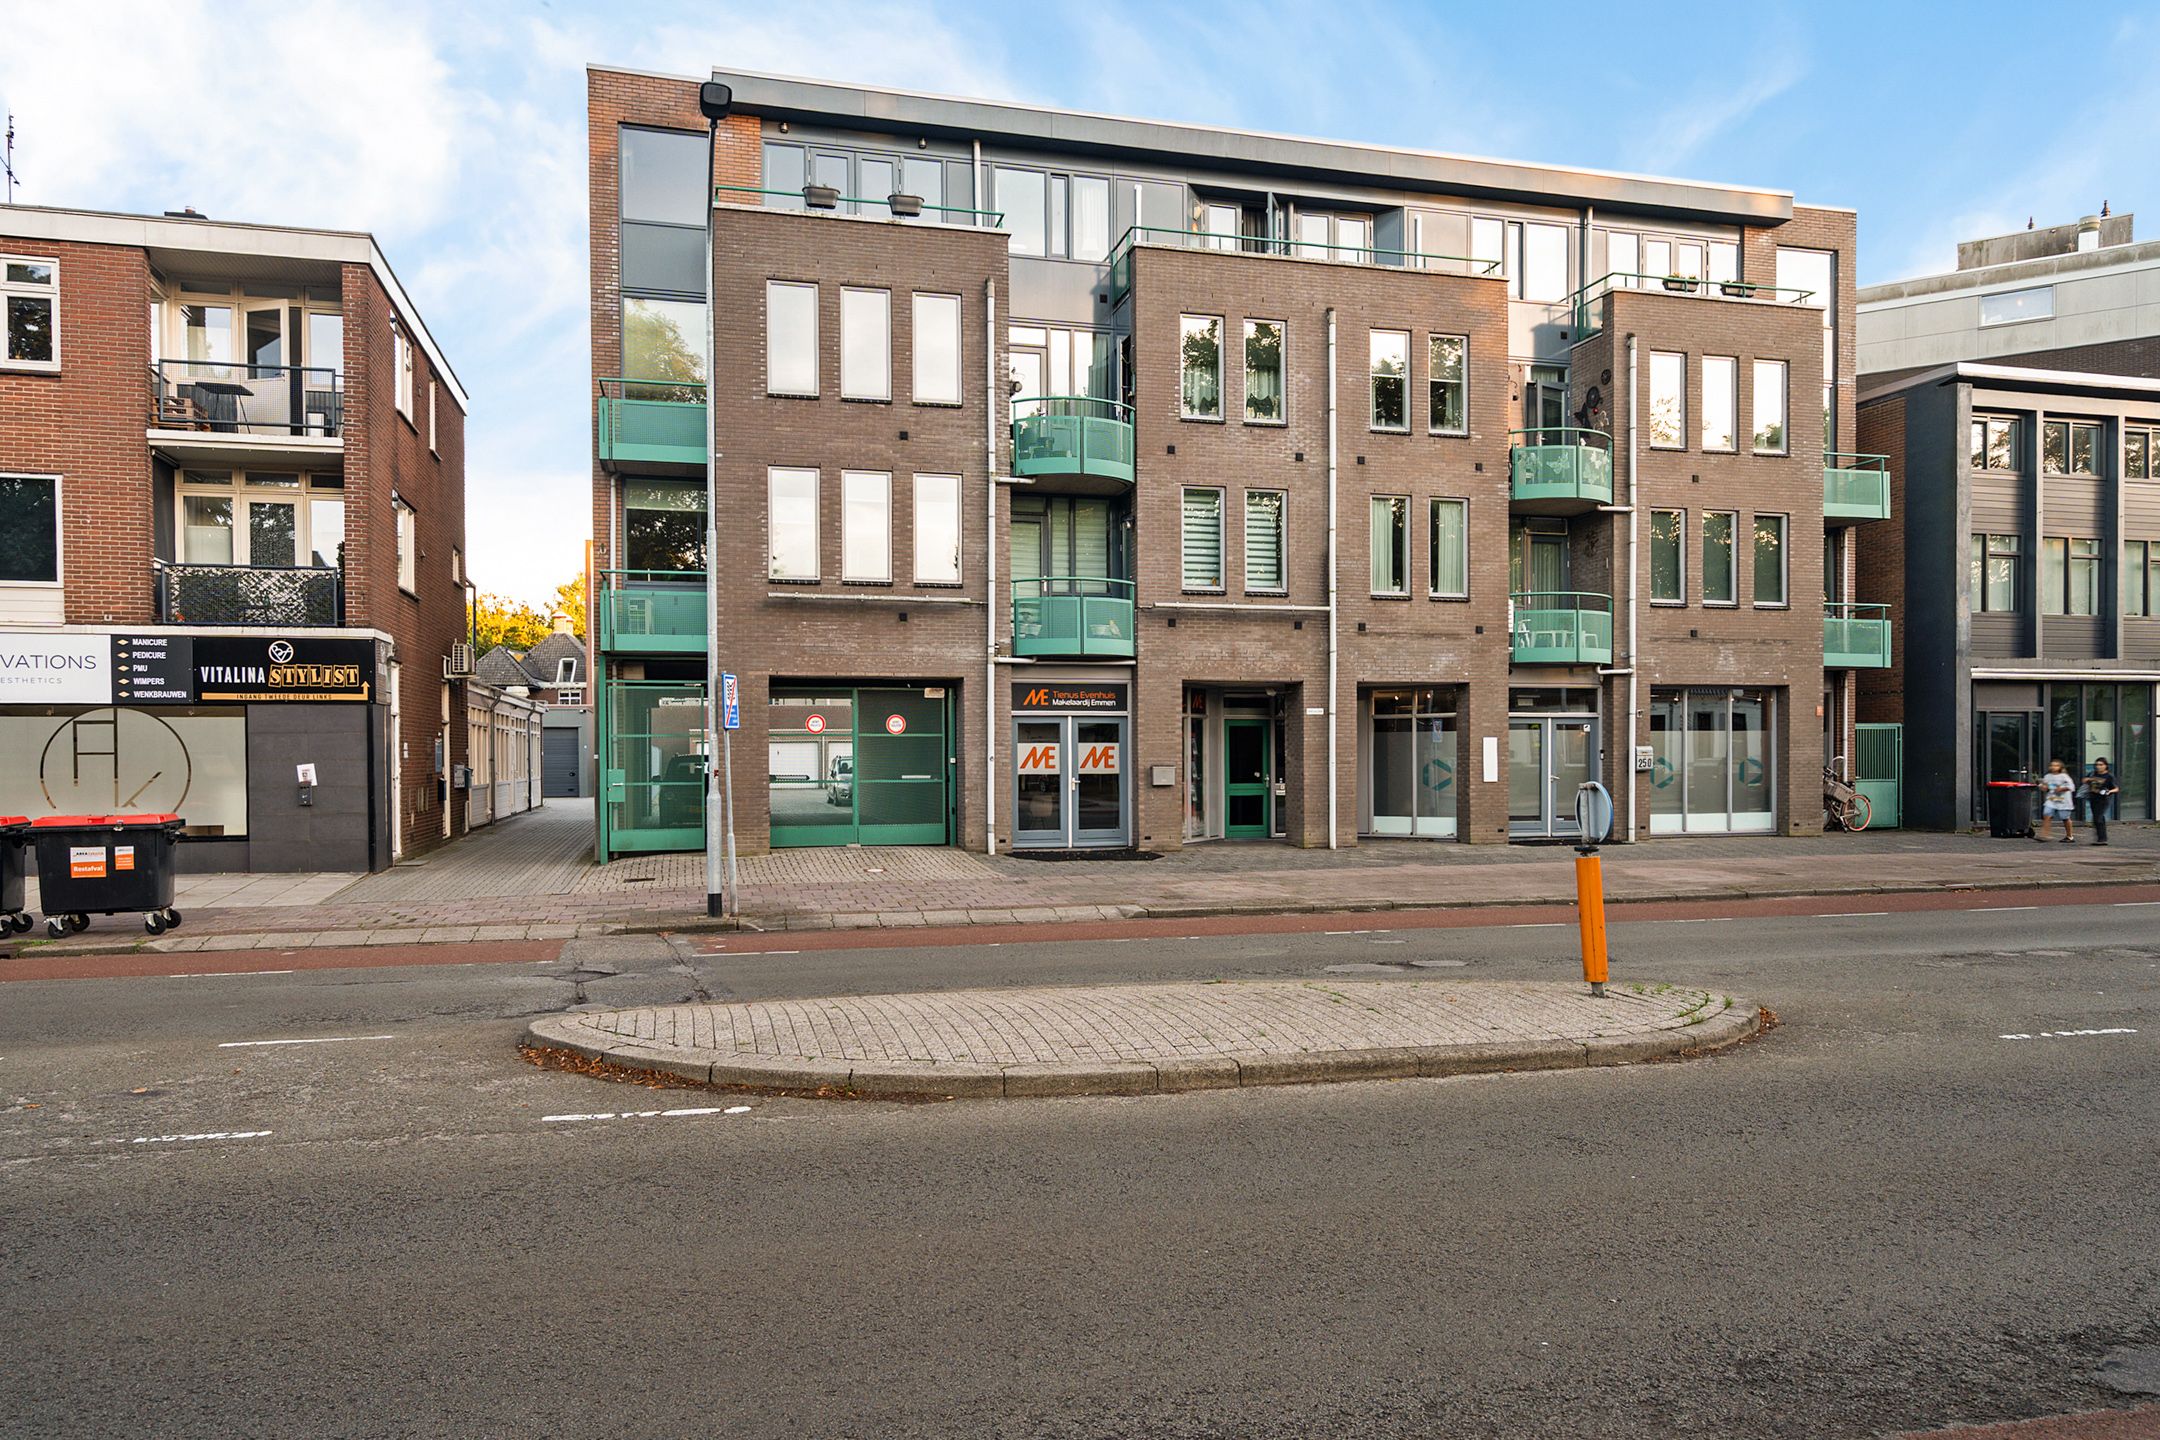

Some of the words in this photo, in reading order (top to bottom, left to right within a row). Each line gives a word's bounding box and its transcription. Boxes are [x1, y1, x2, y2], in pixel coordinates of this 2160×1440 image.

[132, 638, 168, 646] MANICURE
[132, 651, 167, 659] PEDICURE
[0, 654, 97, 669] VATIONS
[133, 664, 148, 672] PMU
[200, 666, 266, 684] VITALINA
[269, 666, 358, 686] STYLIST
[133, 677, 165, 685] WIMPERS
[133, 690, 187, 698] WENKBRAUWEN
[1023, 688, 1049, 706] ME
[1052, 690, 1079, 699] Tienus
[1080, 690, 1116, 699] Evenhuis
[1052, 699, 1091, 707] Makelaardij
[1020, 746, 1056, 769] ME
[1080, 746, 1115, 769] ME
[1638, 758, 1652, 768] 250
